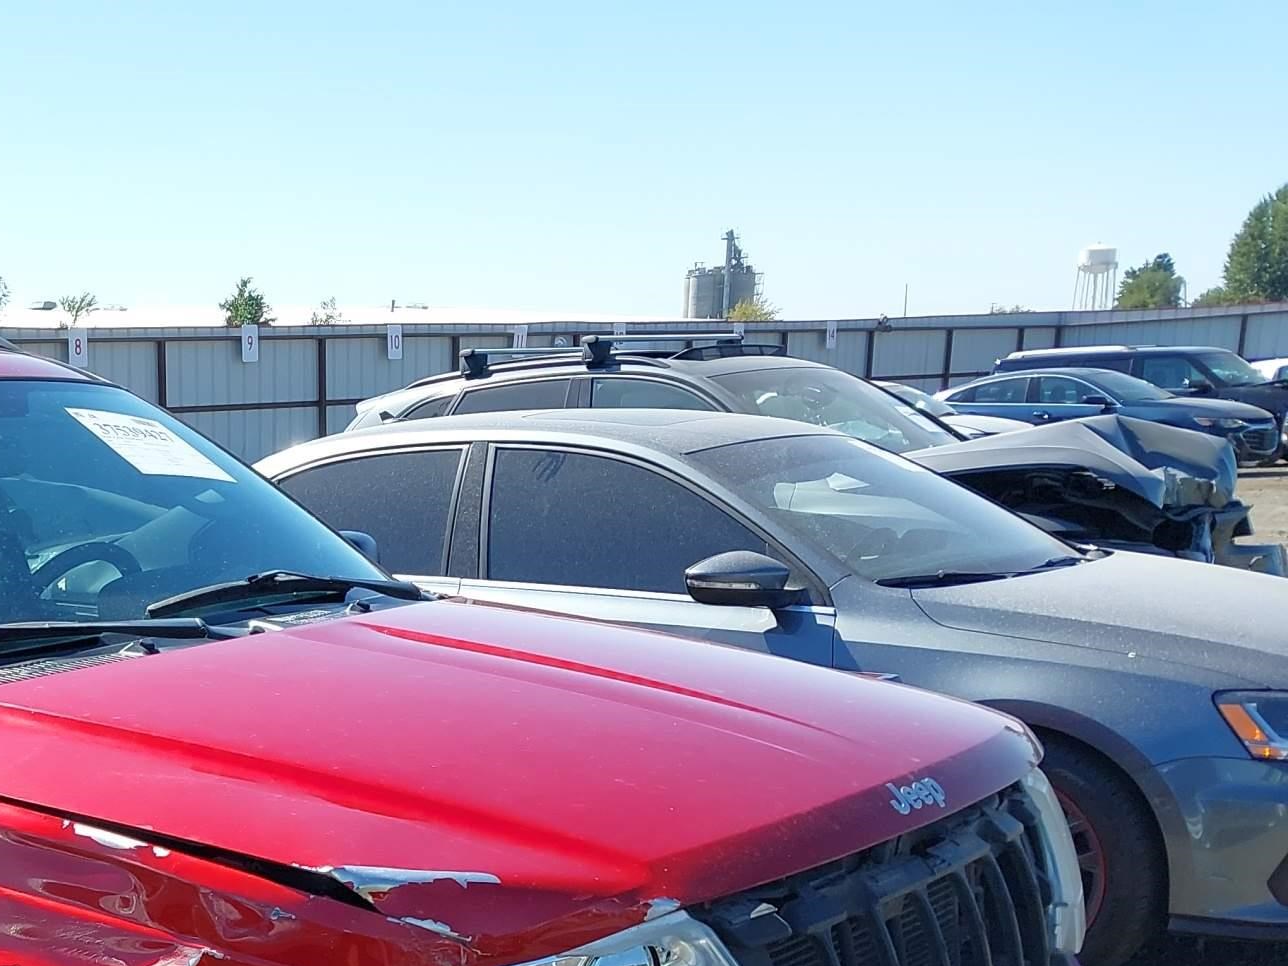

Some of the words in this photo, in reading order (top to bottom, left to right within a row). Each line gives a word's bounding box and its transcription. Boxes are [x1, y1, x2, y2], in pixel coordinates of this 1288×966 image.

[390, 335, 400, 349] 10
[828, 328, 835, 340] 14
[74, 338, 82, 355] 8
[247, 335, 253, 351] 9
[886, 777, 946, 815] Jeep
